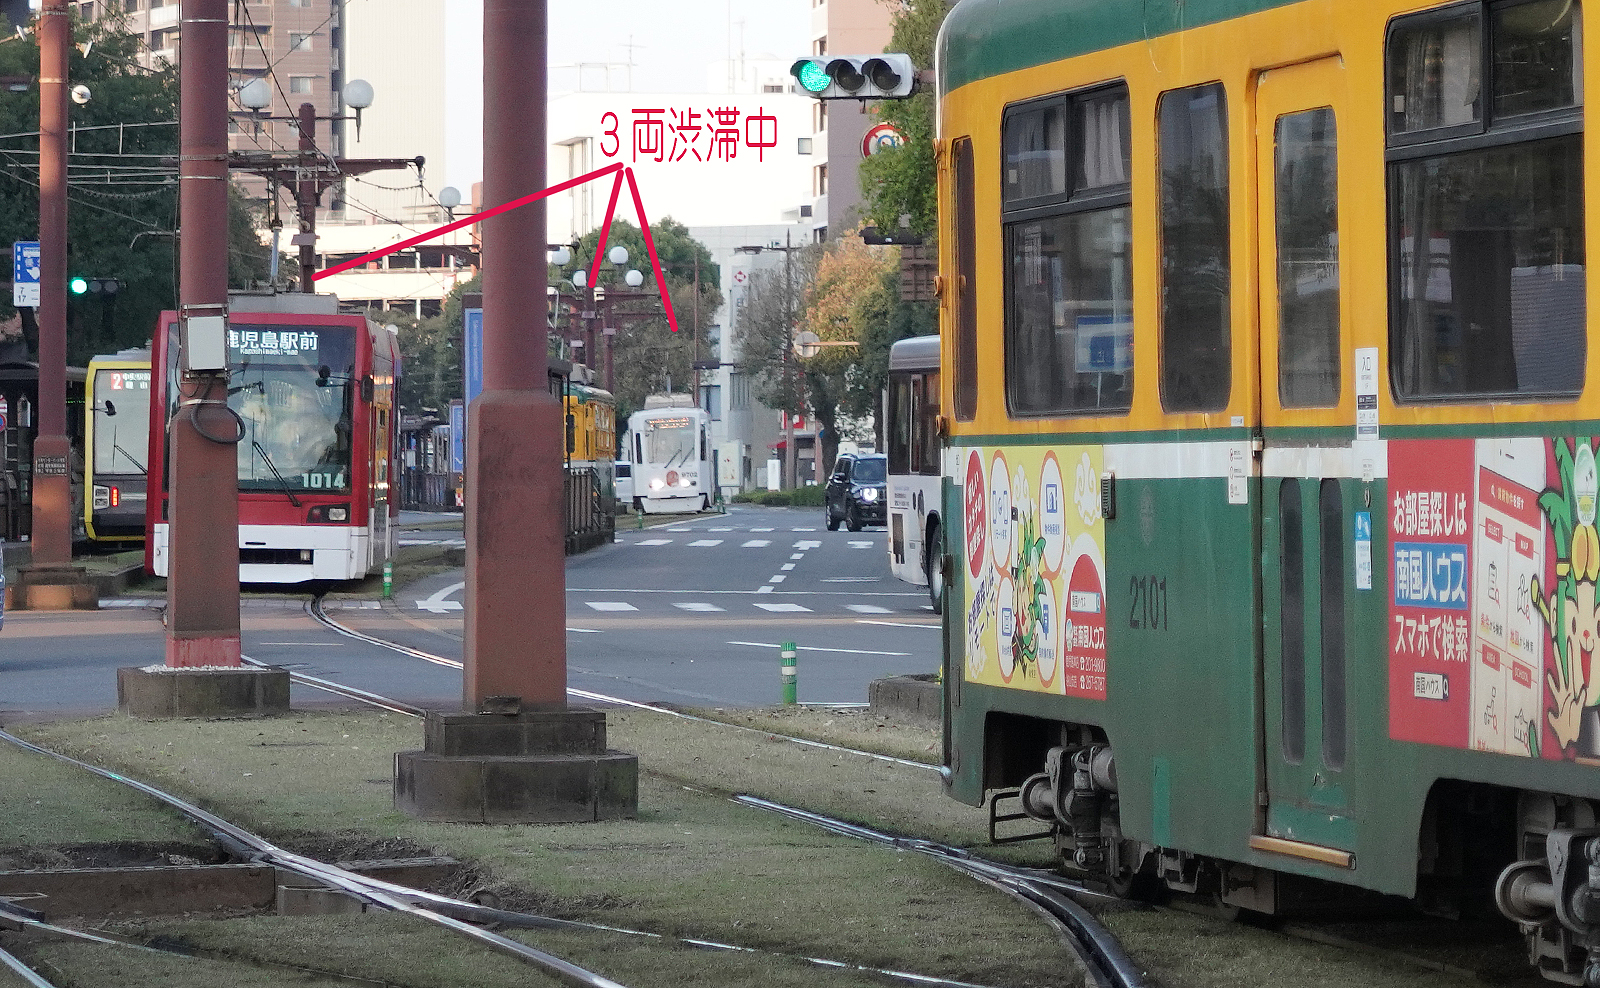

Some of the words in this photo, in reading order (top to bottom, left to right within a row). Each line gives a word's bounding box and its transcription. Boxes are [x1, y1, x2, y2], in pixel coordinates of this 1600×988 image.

[112, 373, 122, 390] 2
[301, 472, 346, 489] 1014
[1393, 490, 1467, 537] お部屋探しは
[1396, 549, 1466, 603] 南国ハウス
[1129, 574, 1167, 631] 2101
[1395, 614, 1468, 663] スマホで検索
